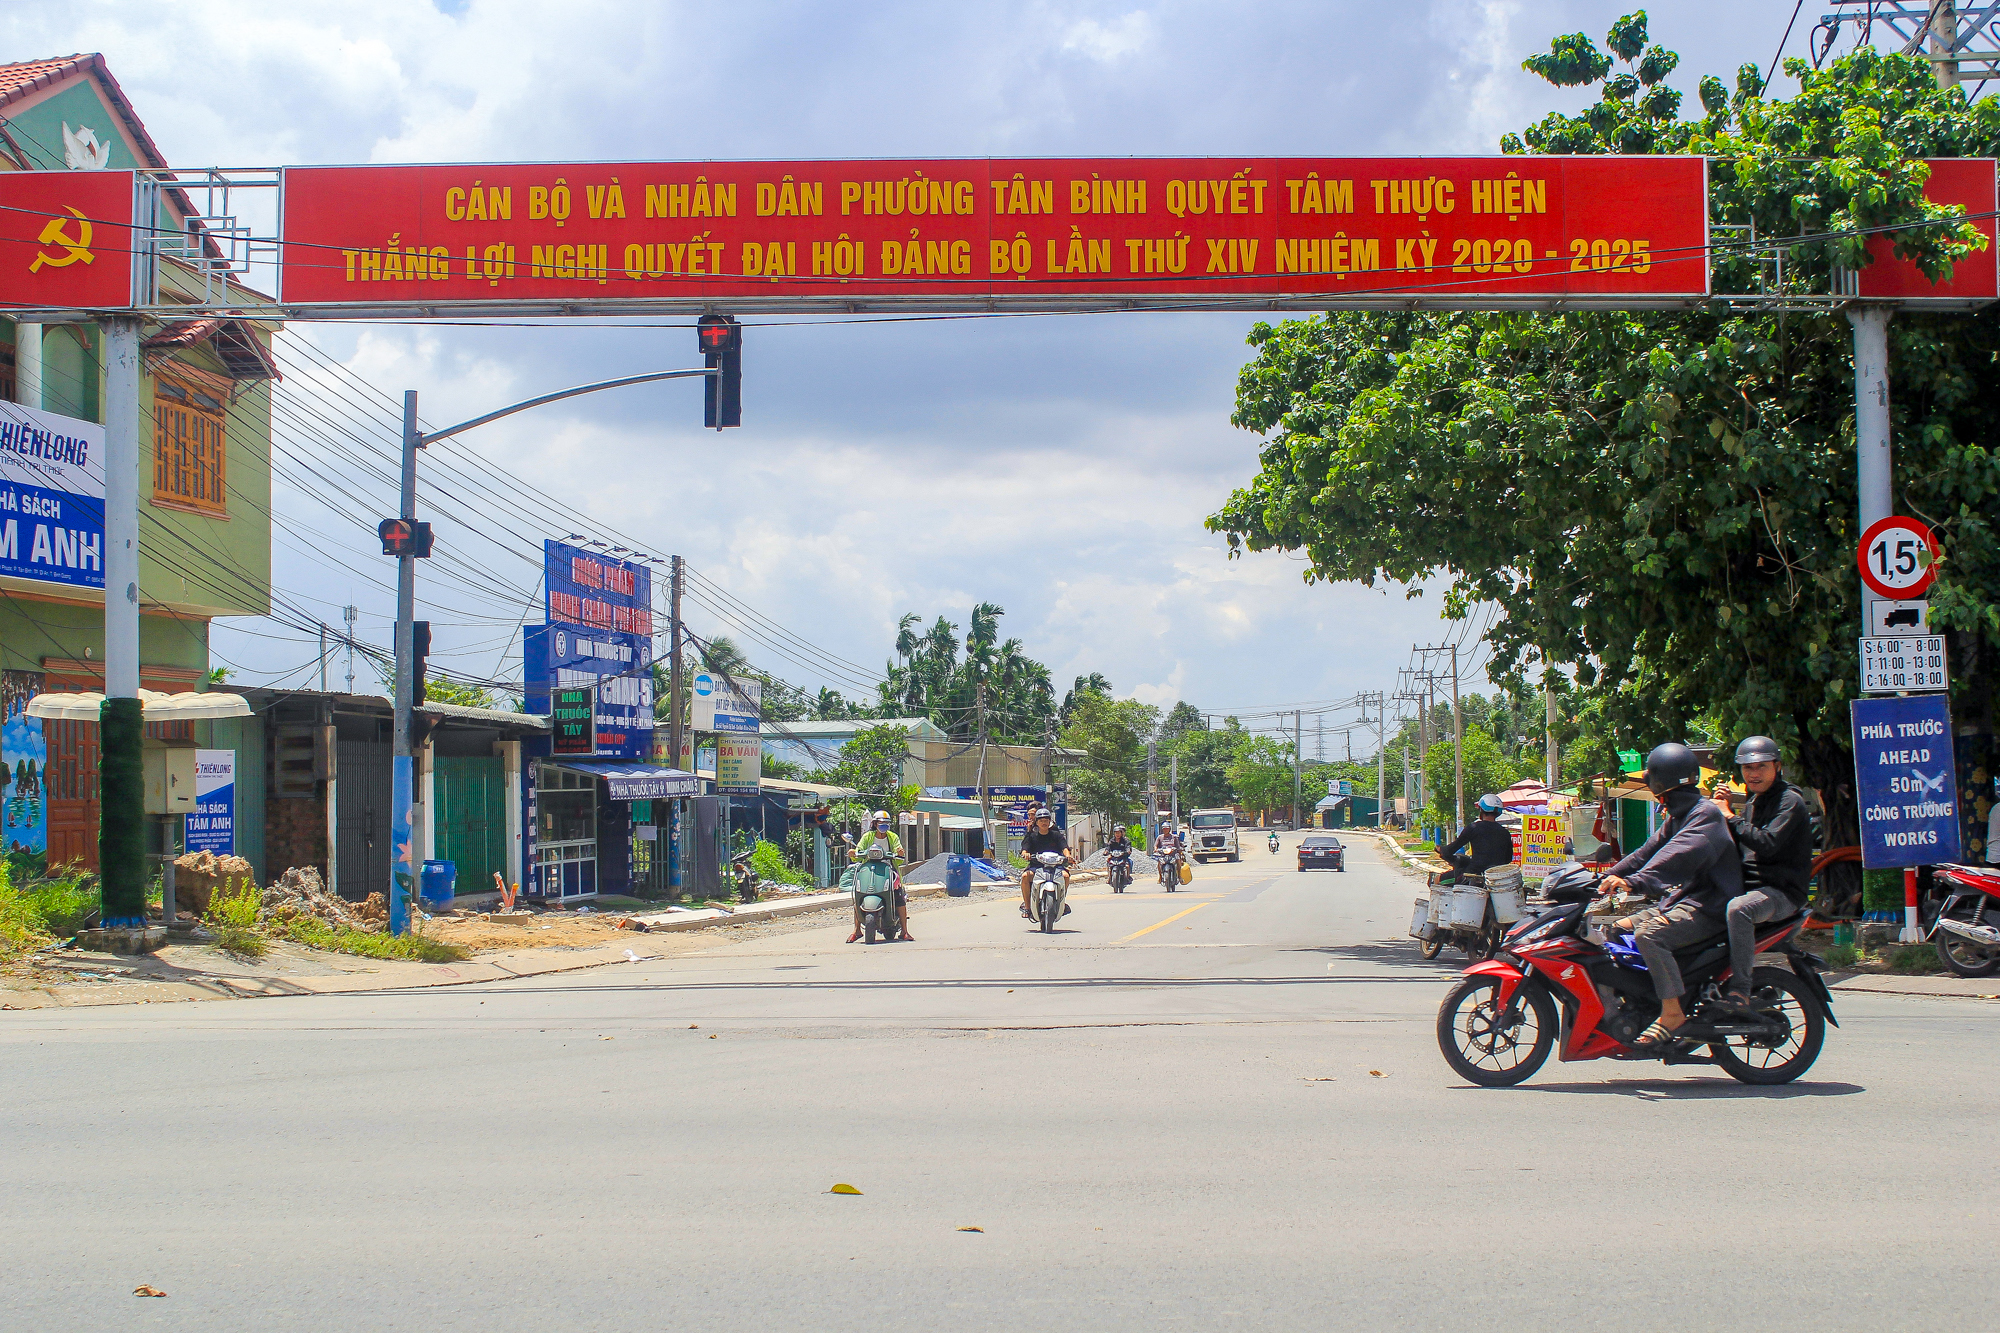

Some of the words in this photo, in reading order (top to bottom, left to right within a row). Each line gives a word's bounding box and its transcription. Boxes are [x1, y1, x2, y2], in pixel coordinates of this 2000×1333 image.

[445, 178, 512, 221] CÁN
[529, 177, 571, 227] BỘ
[586, 176, 626, 219] VÀ
[645, 175, 737, 219] NHÂN
[756, 174, 823, 217] DÂN
[841, 170, 974, 216] PHƯỜNG
[990, 172, 1054, 215] TÂN
[1070, 172, 1147, 215] BÌNH
[1166, 167, 1268, 218] QUYẾT
[1285, 171, 1354, 214] TÂM
[1370, 176, 1455, 222] THỰC
[1471, 171, 1547, 222] HIỆN
[341, 232, 449, 282] THẮNG
[466, 241, 515, 287] LỢI
[531, 244, 608, 285] NGHỊ
[624, 230, 725, 280] QUYẾT
[741, 241, 796, 283] ĐẠI
[812, 232, 864, 284] HỘI
[880, 227, 971, 275] ĐẢNG
[989, 231, 1032, 281] BỘ
[1047, 225, 1111, 274] LẦN
[1124, 230, 1191, 274] THỨ
[1205, 238, 1259, 274] XIV
[1275, 231, 1380, 280] NHIỆM
[1395, 230, 1438, 274] KỲ
[1452, 238, 1533, 274] 2020
[1569, 238, 1651, 275] 2025
[0, 421, 88, 467] HIÊNLONG
[0, 486, 18, 512] HÀ
[22, 491, 60, 520] SÁCH
[31, 524, 100, 571] ANH
[1916, 638, 1941, 652] 8:00
[555, 704, 591, 719] THUỐC
[562, 723, 583, 736] TÂY
[1860, 722, 1893, 740] PHÍA
[1897, 718, 1944, 738] TRƯỚC
[719, 747, 734, 757] BA
[737, 744, 758, 757] VĂN
[1879, 748, 1930, 765] AHEAD
[615, 783, 629, 796] NHÀ
[628, 779, 649, 795] THUỐC
[649, 782, 660, 794] TÂY
[208, 801, 228, 814] SÁCH
[1865, 804, 1899, 821] CÔNG
[1902, 800, 1953, 819] TRƯỜNG
[211, 817, 232, 830] ANH
[1528, 817, 1558, 832] BIA
[1525, 833, 1546, 844] TƯƠI
[1883, 830, 1938, 847] WORKS
